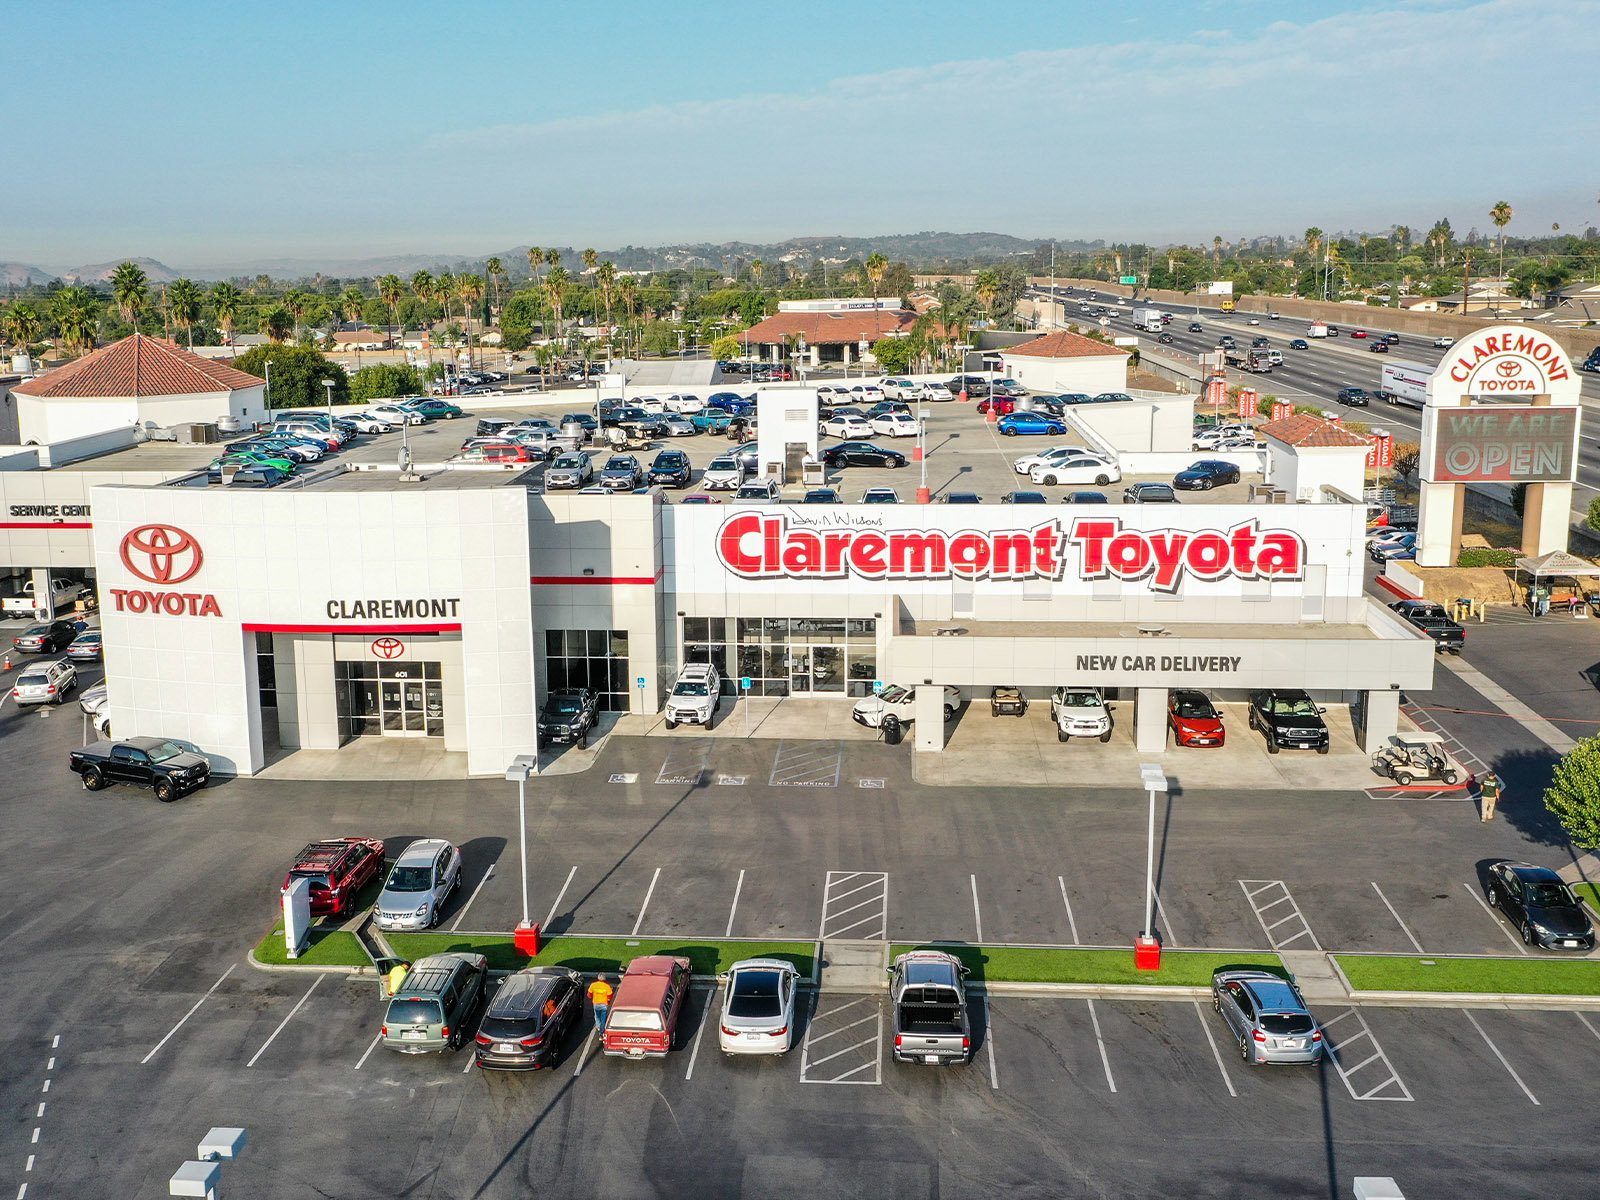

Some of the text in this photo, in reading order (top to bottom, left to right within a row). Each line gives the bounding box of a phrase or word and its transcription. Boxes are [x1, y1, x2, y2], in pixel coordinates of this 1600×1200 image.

[1450, 333, 1569, 382] CLAREMONT
[1479, 380, 1535, 391] TOYOTA
[1450, 414, 1566, 437] WE ARE
[1445, 441, 1564, 476] OPEN
[9, 504, 91, 517] SERVICE CENT
[718, 513, 1303, 589] Claremont Toyota
[109, 588, 223, 617] TOYOTA
[326, 597, 461, 620] CLAREMONT
[1076, 654, 1242, 673] NEW CAR DELIVERY
